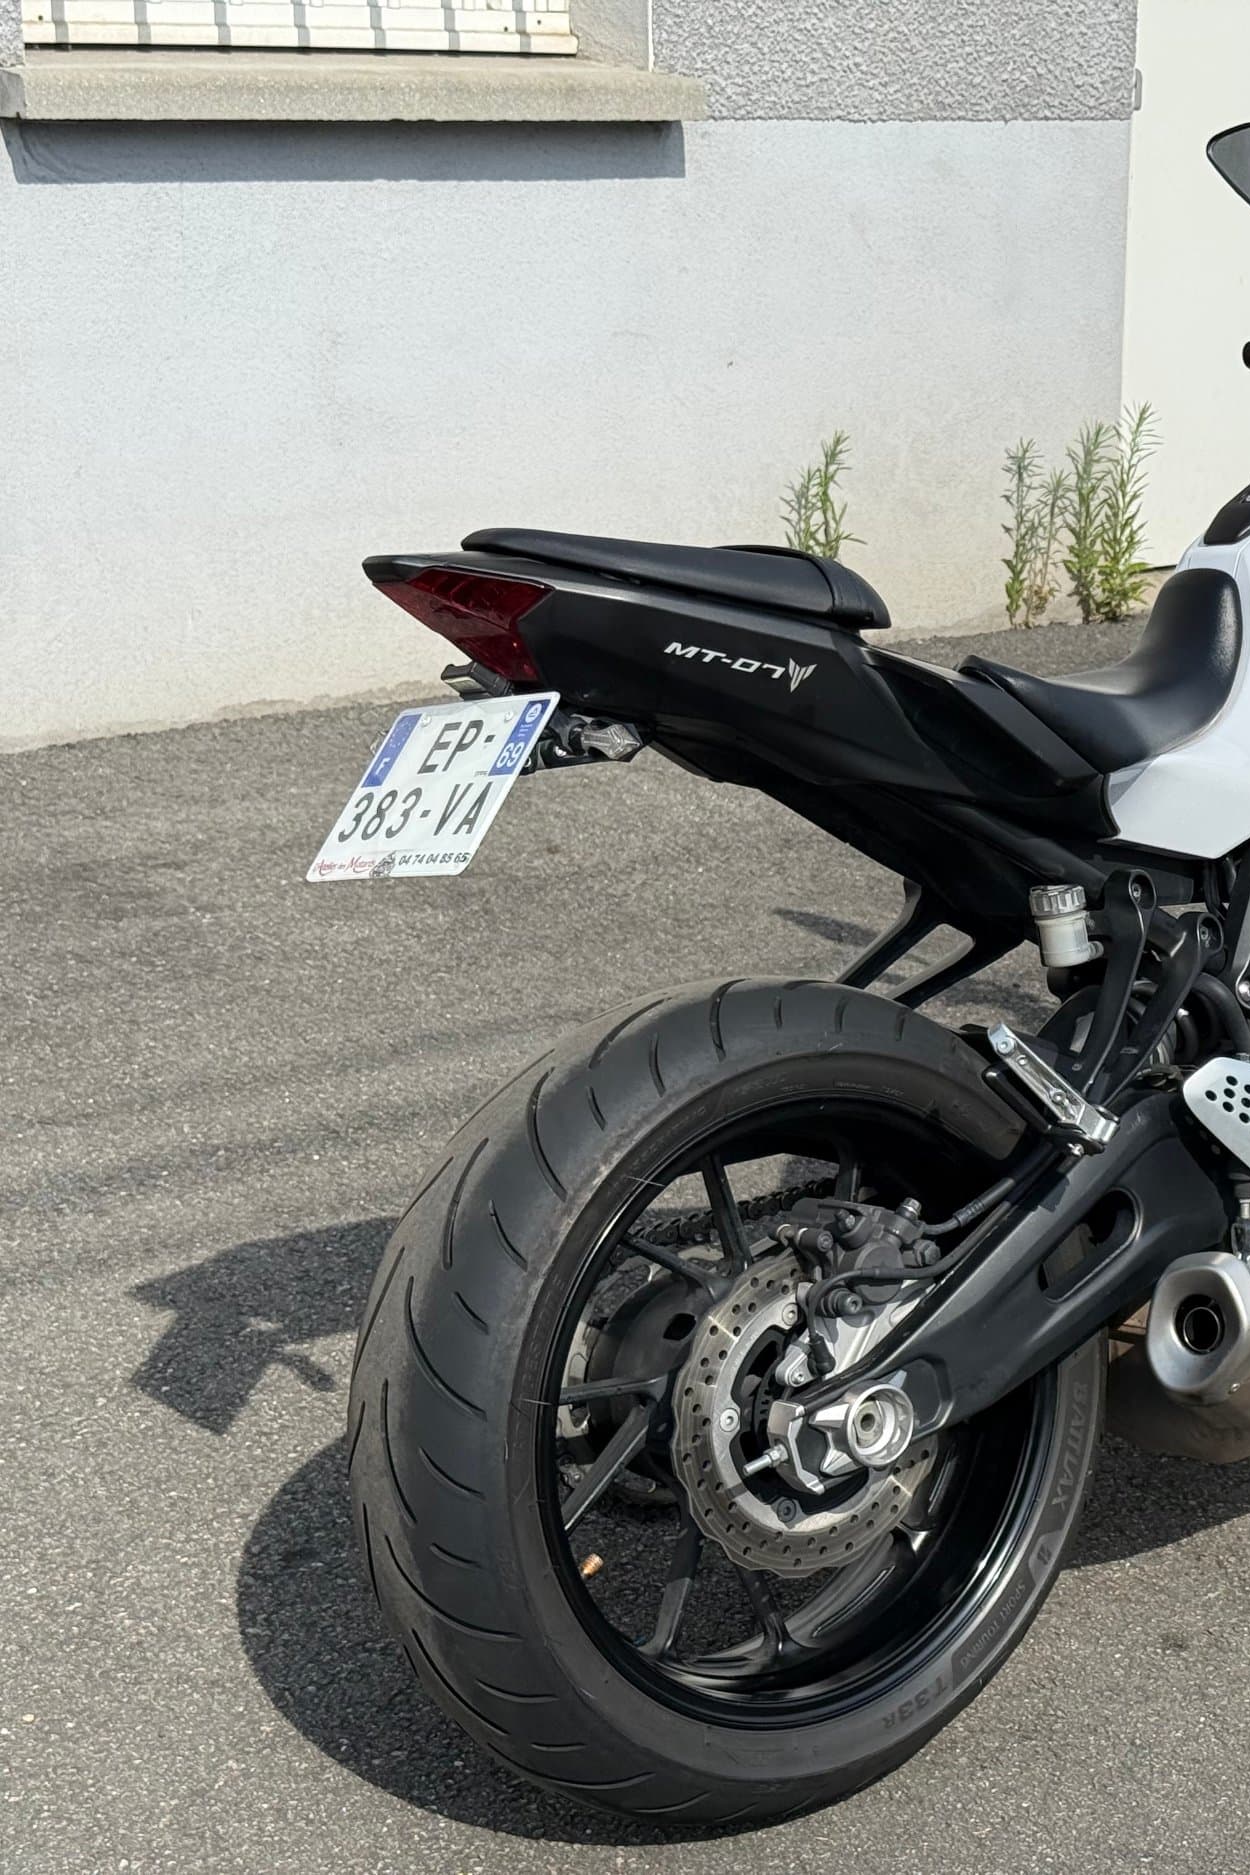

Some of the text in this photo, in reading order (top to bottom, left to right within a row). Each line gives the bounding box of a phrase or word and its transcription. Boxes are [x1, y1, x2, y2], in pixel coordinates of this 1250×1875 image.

[664, 642, 786, 679] MT-07
[375, 757, 390, 775] F
[496, 741, 525, 769] 69
[338, 781, 493, 843] 383-VA
